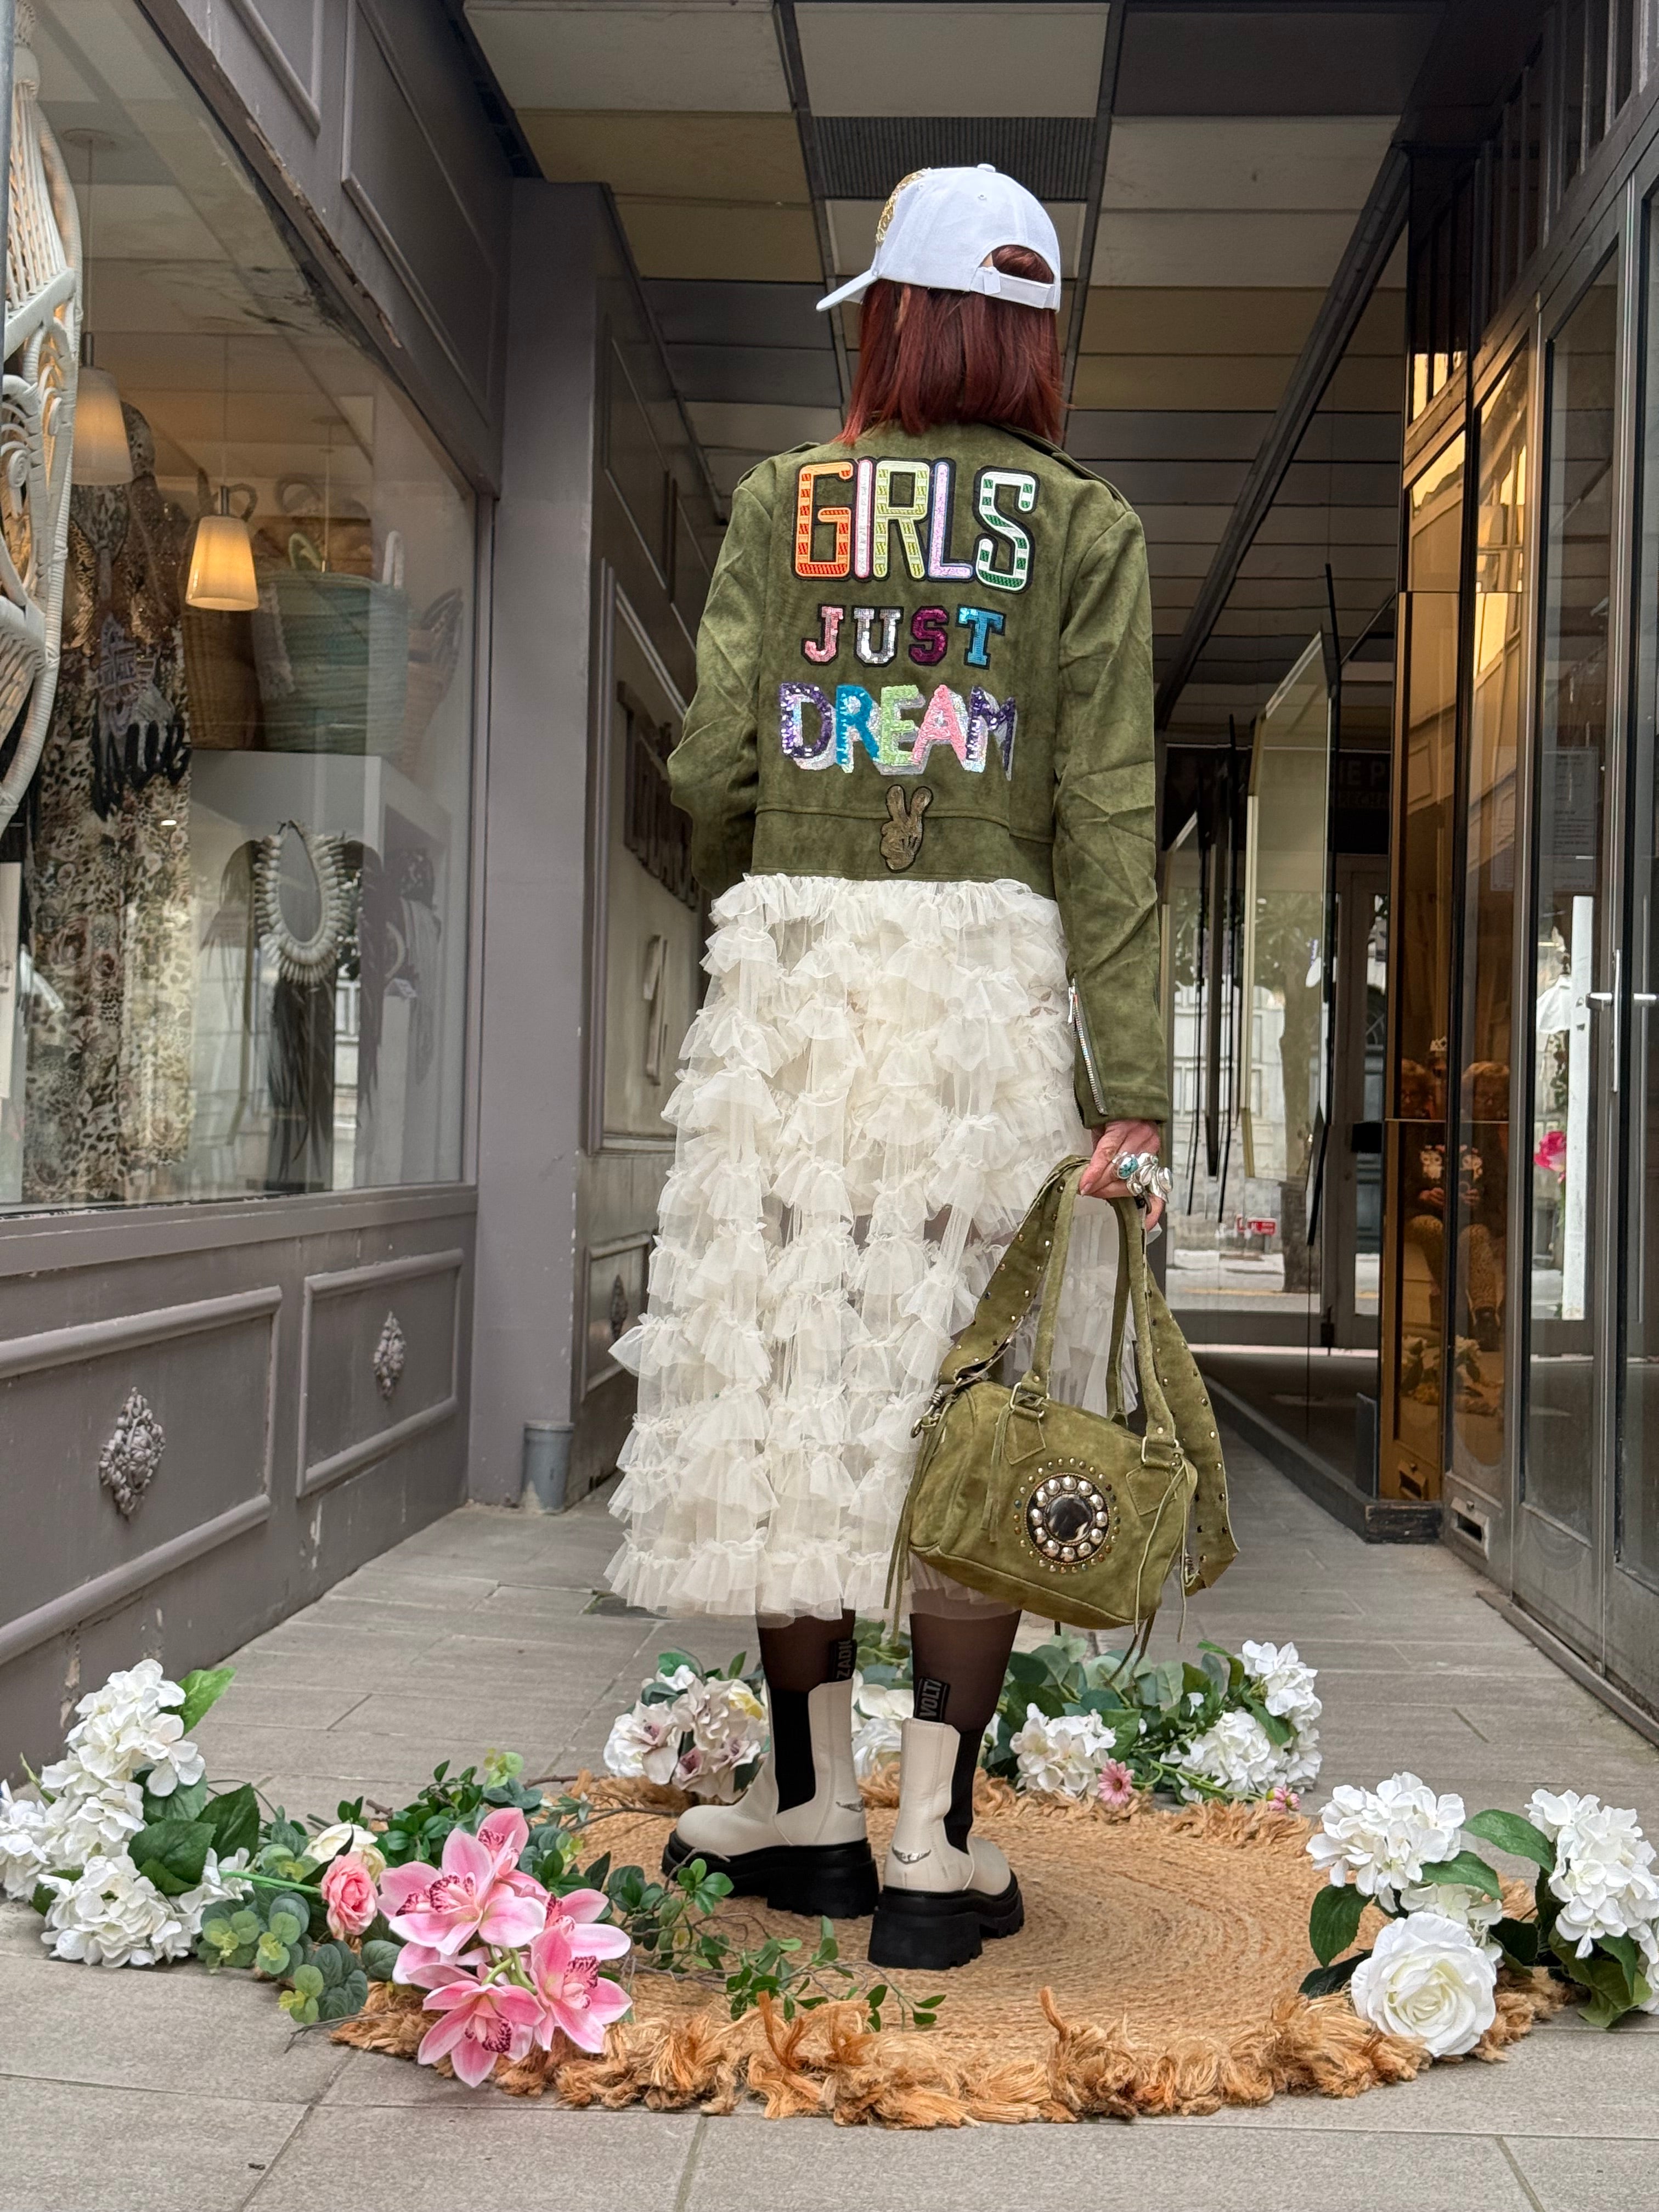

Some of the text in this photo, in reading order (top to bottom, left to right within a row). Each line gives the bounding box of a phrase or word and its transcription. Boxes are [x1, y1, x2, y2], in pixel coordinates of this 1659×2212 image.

[793, 457, 1038, 592] GIRLS
[802, 605, 1005, 668] JUST
[778, 682, 1018, 780] DREAM
